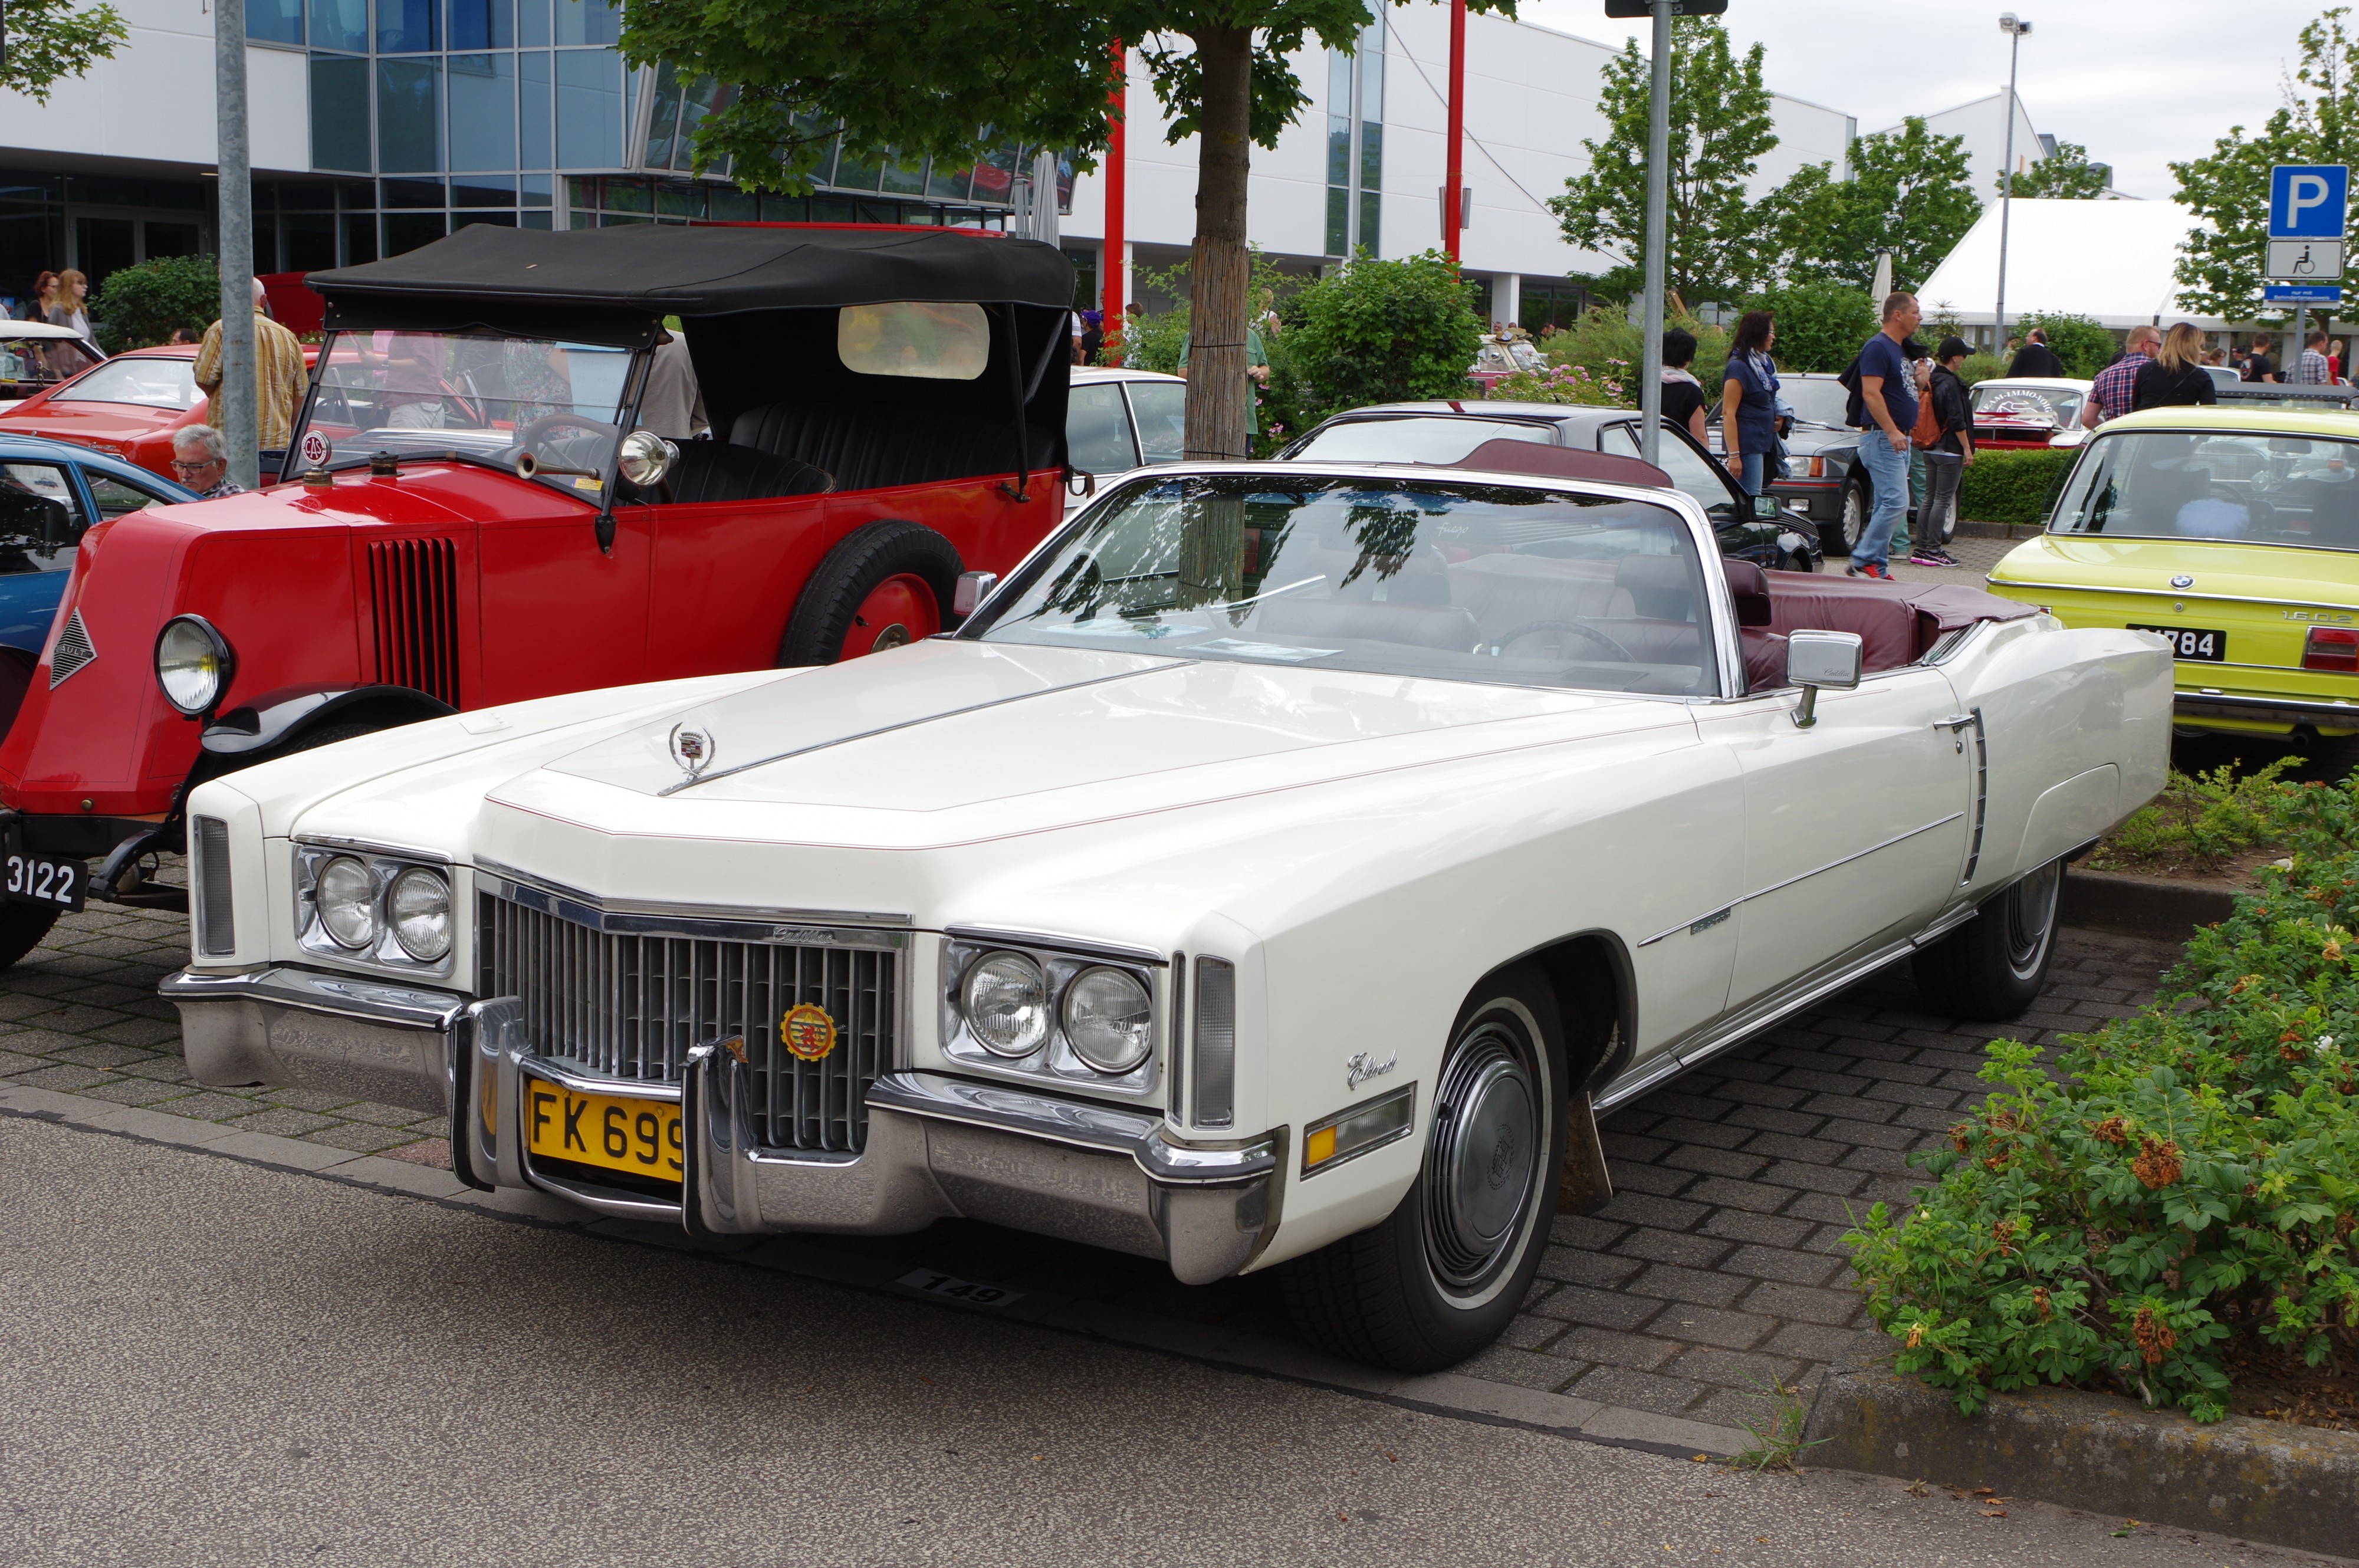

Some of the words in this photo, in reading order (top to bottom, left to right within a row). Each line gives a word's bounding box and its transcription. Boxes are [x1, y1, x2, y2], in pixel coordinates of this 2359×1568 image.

[2287, 175, 2329, 228] P
[305, 438, 322, 459] CAS
[2139, 629, 2214, 656] 784
[8, 856, 74, 903] 3122
[773, 926, 833, 944] Cadillac
[534, 1092, 589, 1152] FK
[921, 1276, 1006, 1303] 149
